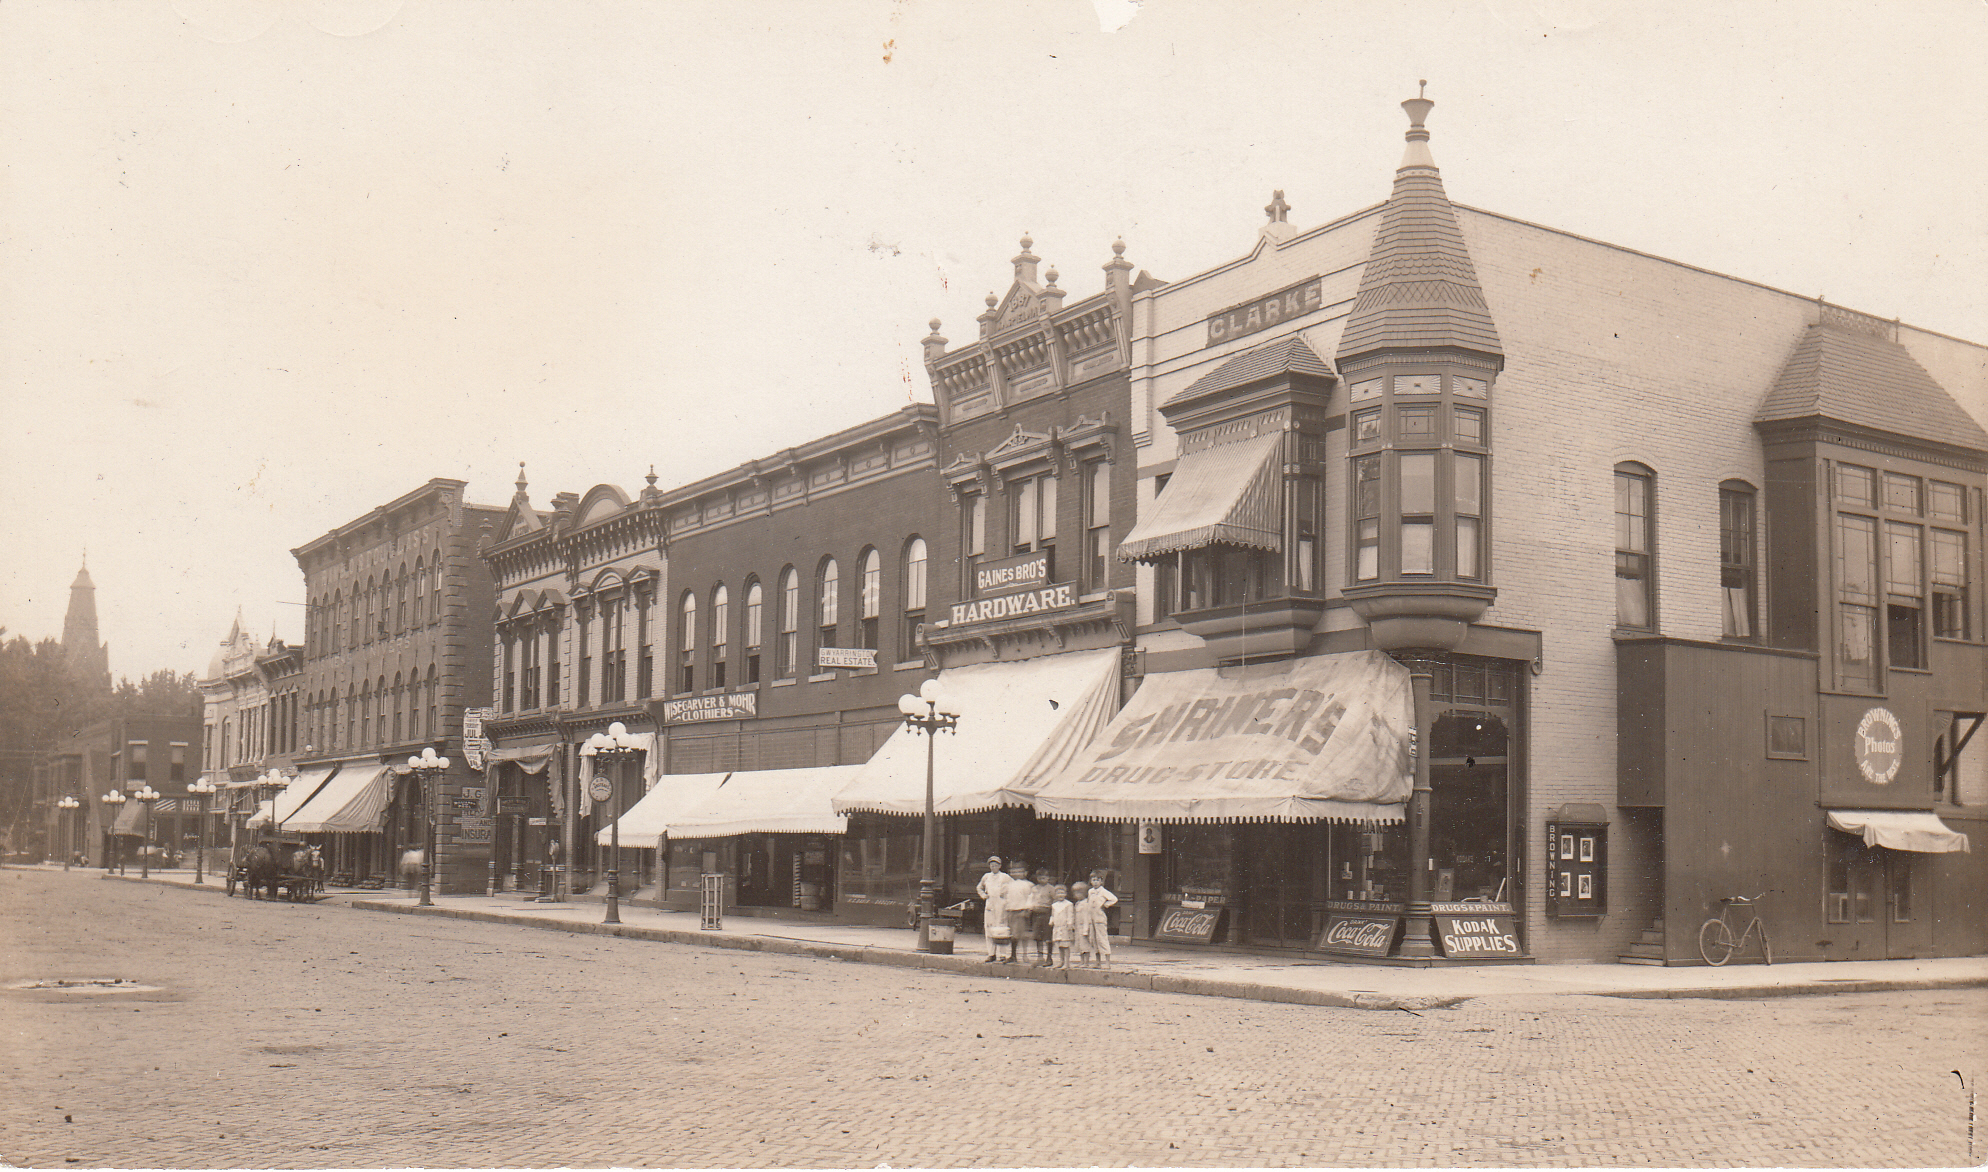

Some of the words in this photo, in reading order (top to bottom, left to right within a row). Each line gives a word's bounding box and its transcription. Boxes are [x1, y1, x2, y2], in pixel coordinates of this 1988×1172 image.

[1210, 283, 1320, 338] CLARKE
[978, 568, 1013, 589] GAINES
[1015, 558, 1046, 580] BRO'S
[951, 585, 1076, 625] HARDWARE.
[820, 656, 841, 665] REAL
[843, 657, 875, 666] ESTATE.
[664, 697, 717, 723] WISEGARVER
[719, 696, 726, 707] &
[728, 693, 756, 715] MOHR
[681, 707, 734, 721] CLOTHIERS
[1094, 687, 1347, 762] SHRINER'S
[1863, 736, 1896, 756] Photos
[1861, 760, 1874, 779] ARE
[1875, 772, 1888, 784] THE
[1327, 921, 1391, 947] Coca-Cola
[1451, 918, 1500, 934] KODAK
[1444, 934, 1517, 953] SUPPLIES
